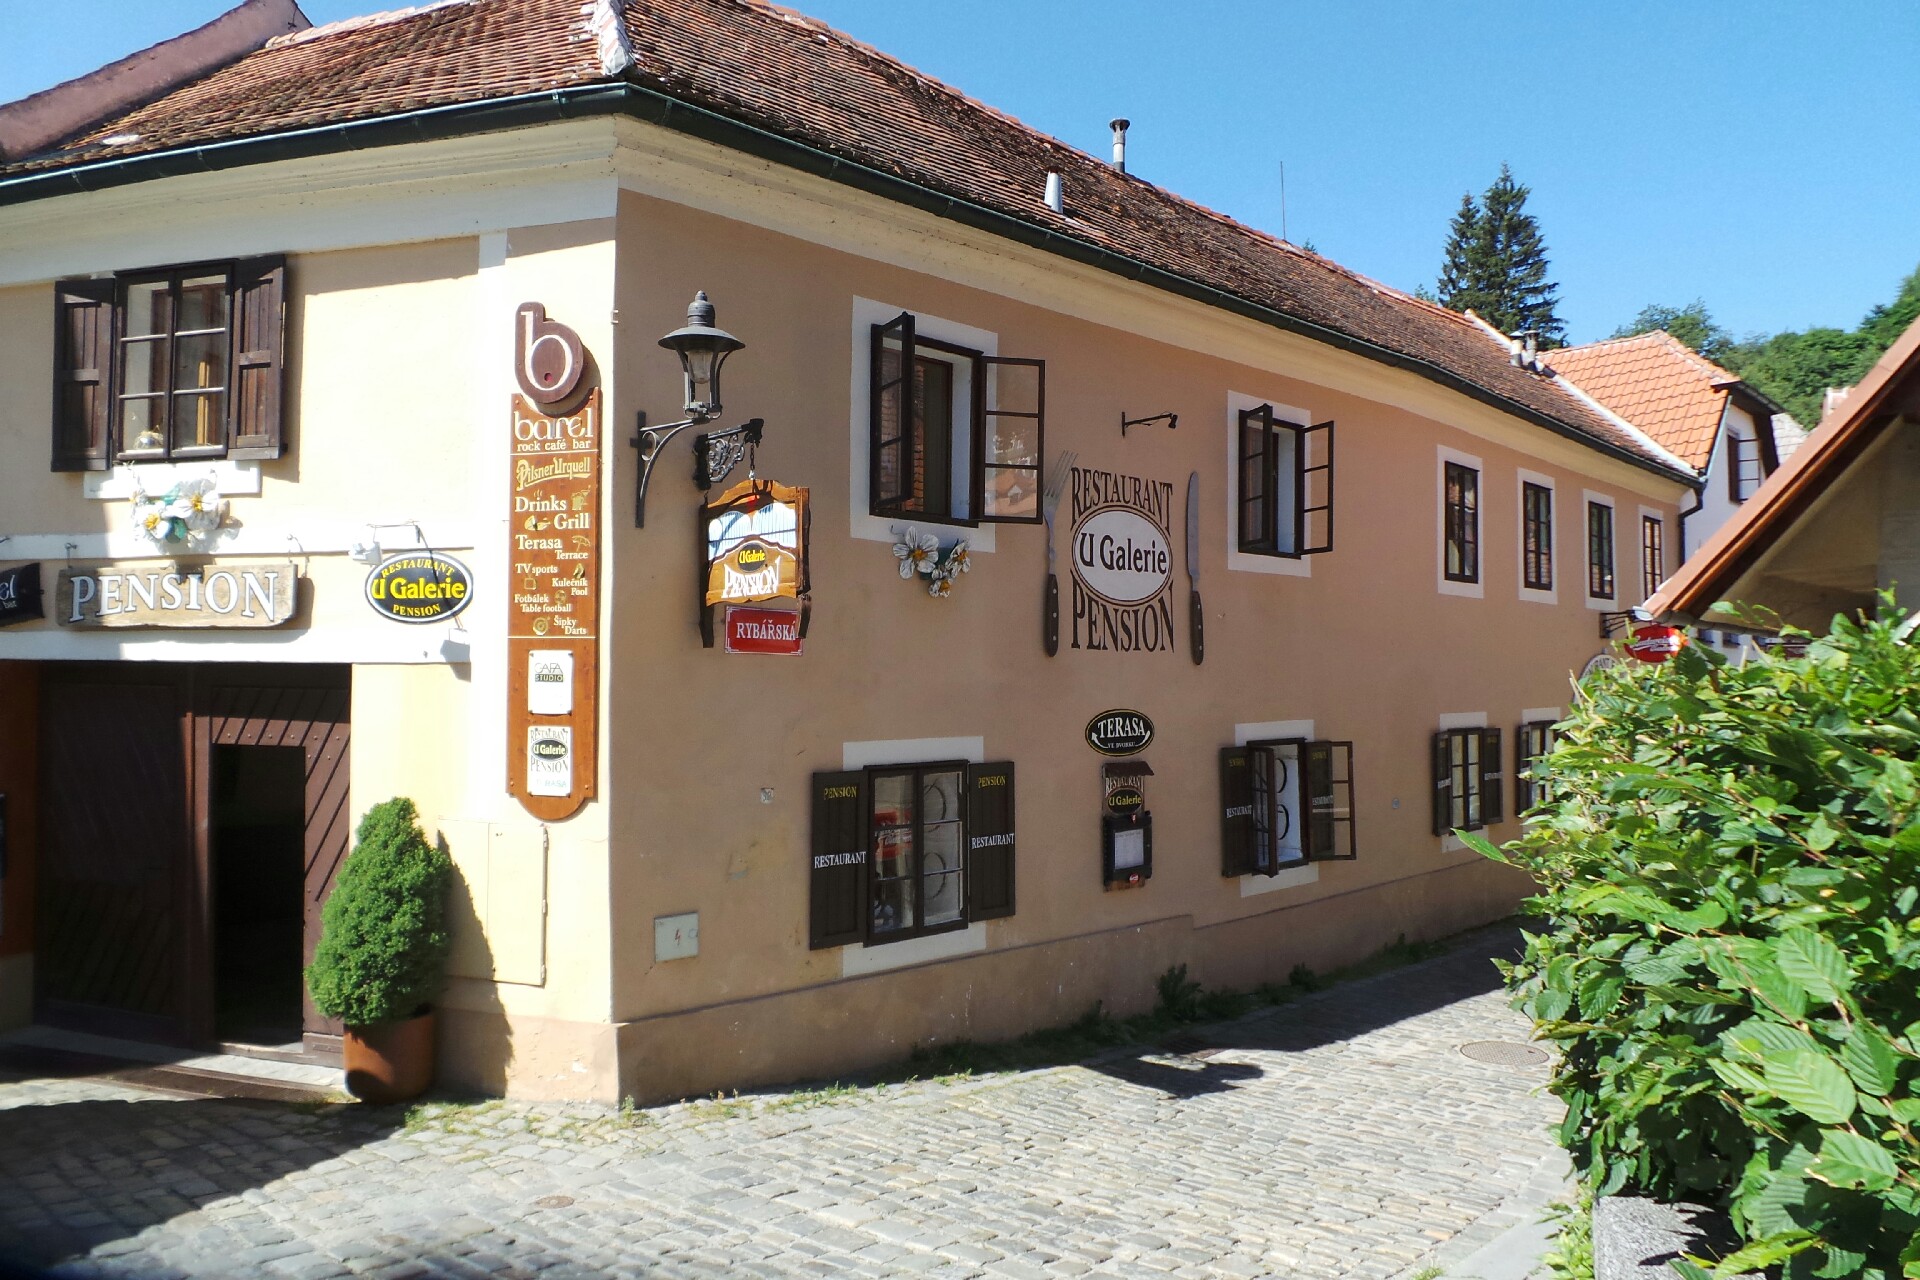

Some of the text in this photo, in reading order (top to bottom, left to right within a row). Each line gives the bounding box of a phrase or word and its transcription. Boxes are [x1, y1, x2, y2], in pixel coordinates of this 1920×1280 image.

[514, 408, 594, 441] barel
[517, 438, 591, 452] rock café bar
[516, 457, 591, 491] Pilsner Urquell
[515, 495, 567, 512] Drinks
[1070, 467, 1173, 538] RESTAURANT
[553, 513, 590, 529] Grill
[515, 535, 563, 550] Terasa
[555, 550, 589, 560] Terrace
[745, 550, 766, 563] Galerie
[1079, 532, 1168, 575] U Galerie
[381, 558, 455, 578] RESTAURANT
[515, 563, 558, 576] TV sports
[721, 555, 781, 599] PENSION
[371, 577, 465, 599] U Galerie
[571, 587, 588, 596] Pool
[69, 572, 279, 624] PENSION
[514, 593, 549, 603] Fotbálek
[393, 603, 441, 617] PENSION
[520, 603, 572, 613] Table football
[1070, 568, 1175, 653] PENSION
[553, 614, 577, 628] Šipky
[564, 626, 587, 635] Darts
[736, 618, 797, 641] RYBÁŘSKÁ
[535, 674, 564, 682] STUDIO
[1097, 717, 1146, 739] TERASA
[540, 744, 566, 755] Galerie
[530, 755, 569, 773] PENSION
[978, 775, 1006, 789] PENSION
[824, 786, 857, 800] PENSION
[1115, 795, 1142, 806] Galerie
[971, 833, 1015, 850] RESTAURANT
[814, 851, 867, 869] RESTAURANT
